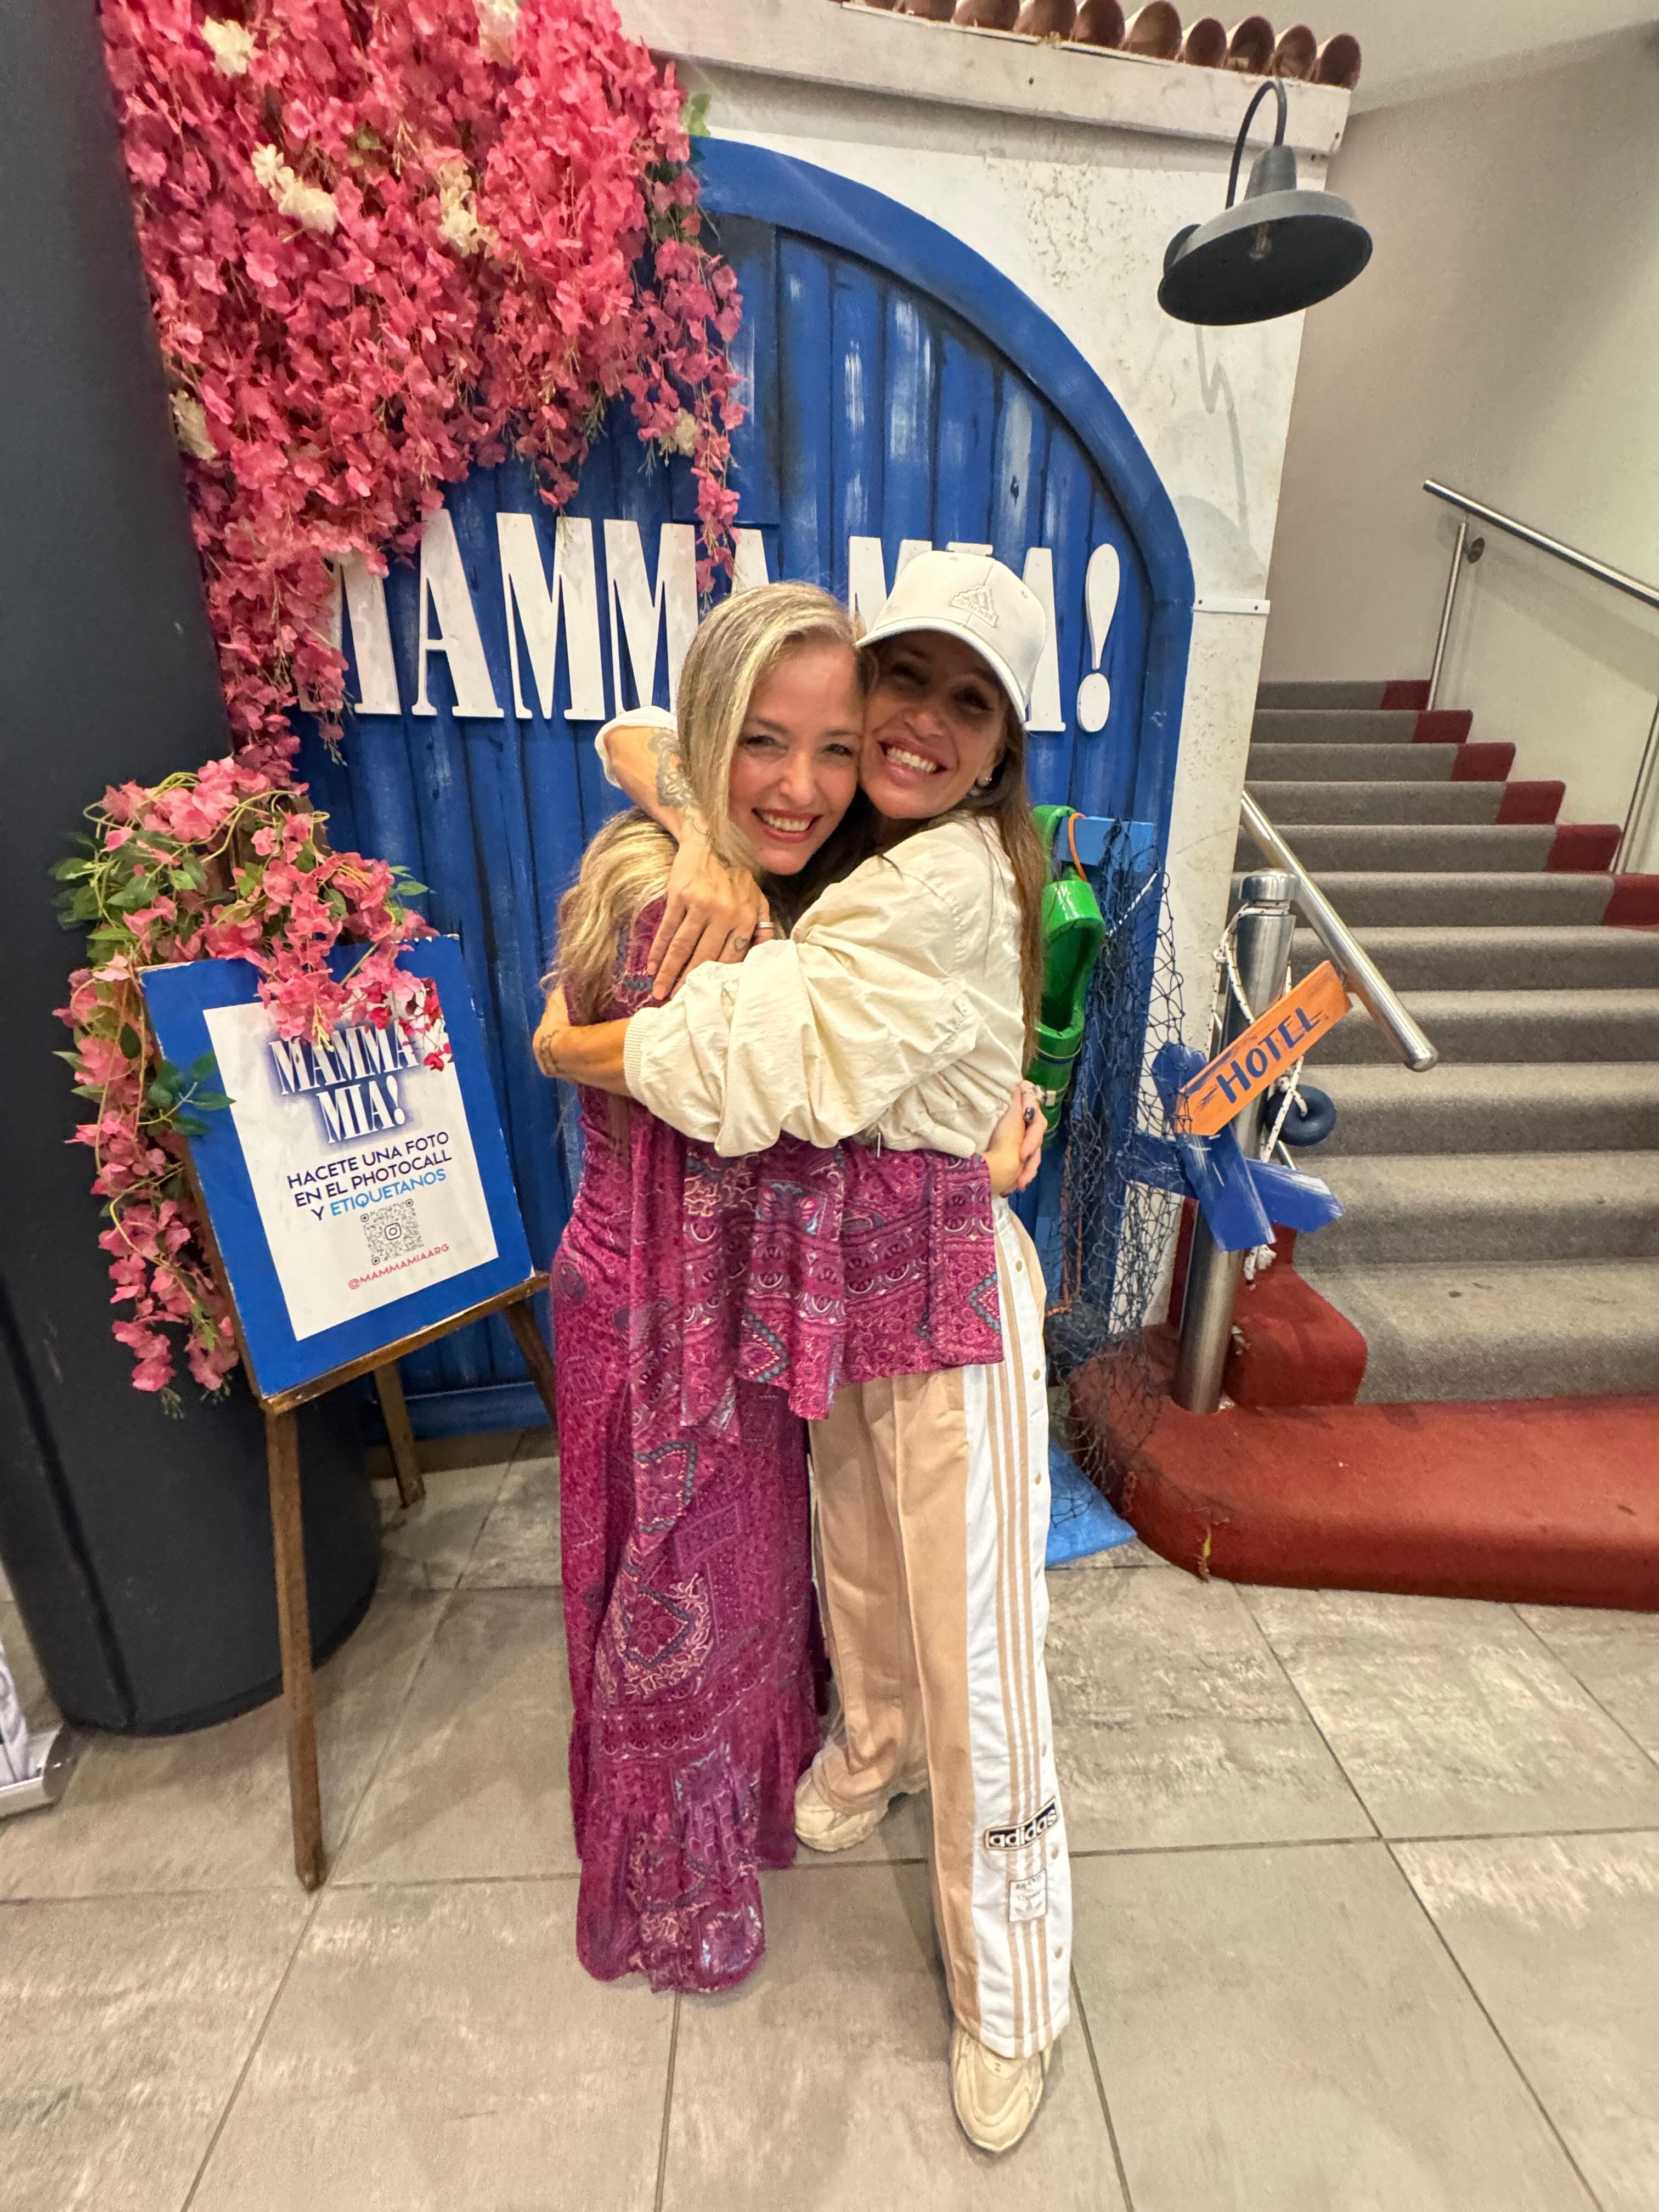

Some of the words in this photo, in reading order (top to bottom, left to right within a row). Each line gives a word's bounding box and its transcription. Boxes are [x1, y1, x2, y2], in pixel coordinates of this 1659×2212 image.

[296, 509, 771, 723] MAMM
[268, 1019, 420, 1095] MAMMA
[1216, 1007, 1321, 1104] HOTEL
[316, 1075, 405, 1144] MIA!
[287, 1156, 359, 1189] HACETE
[362, 1146, 402, 1166] UNA
[405, 1131, 449, 1154] FOTO
[294, 1187, 322, 1207] EN
[326, 1181, 348, 1198] EL
[351, 1149, 452, 1189] PHOTOCALL
[311, 1206, 324, 1221] Y
[330, 1168, 447, 1216] ETIQUETANOS
[348, 1244, 449, 1289] @MAMMAMIAARG
[989, 1809, 1057, 1848] adidas
